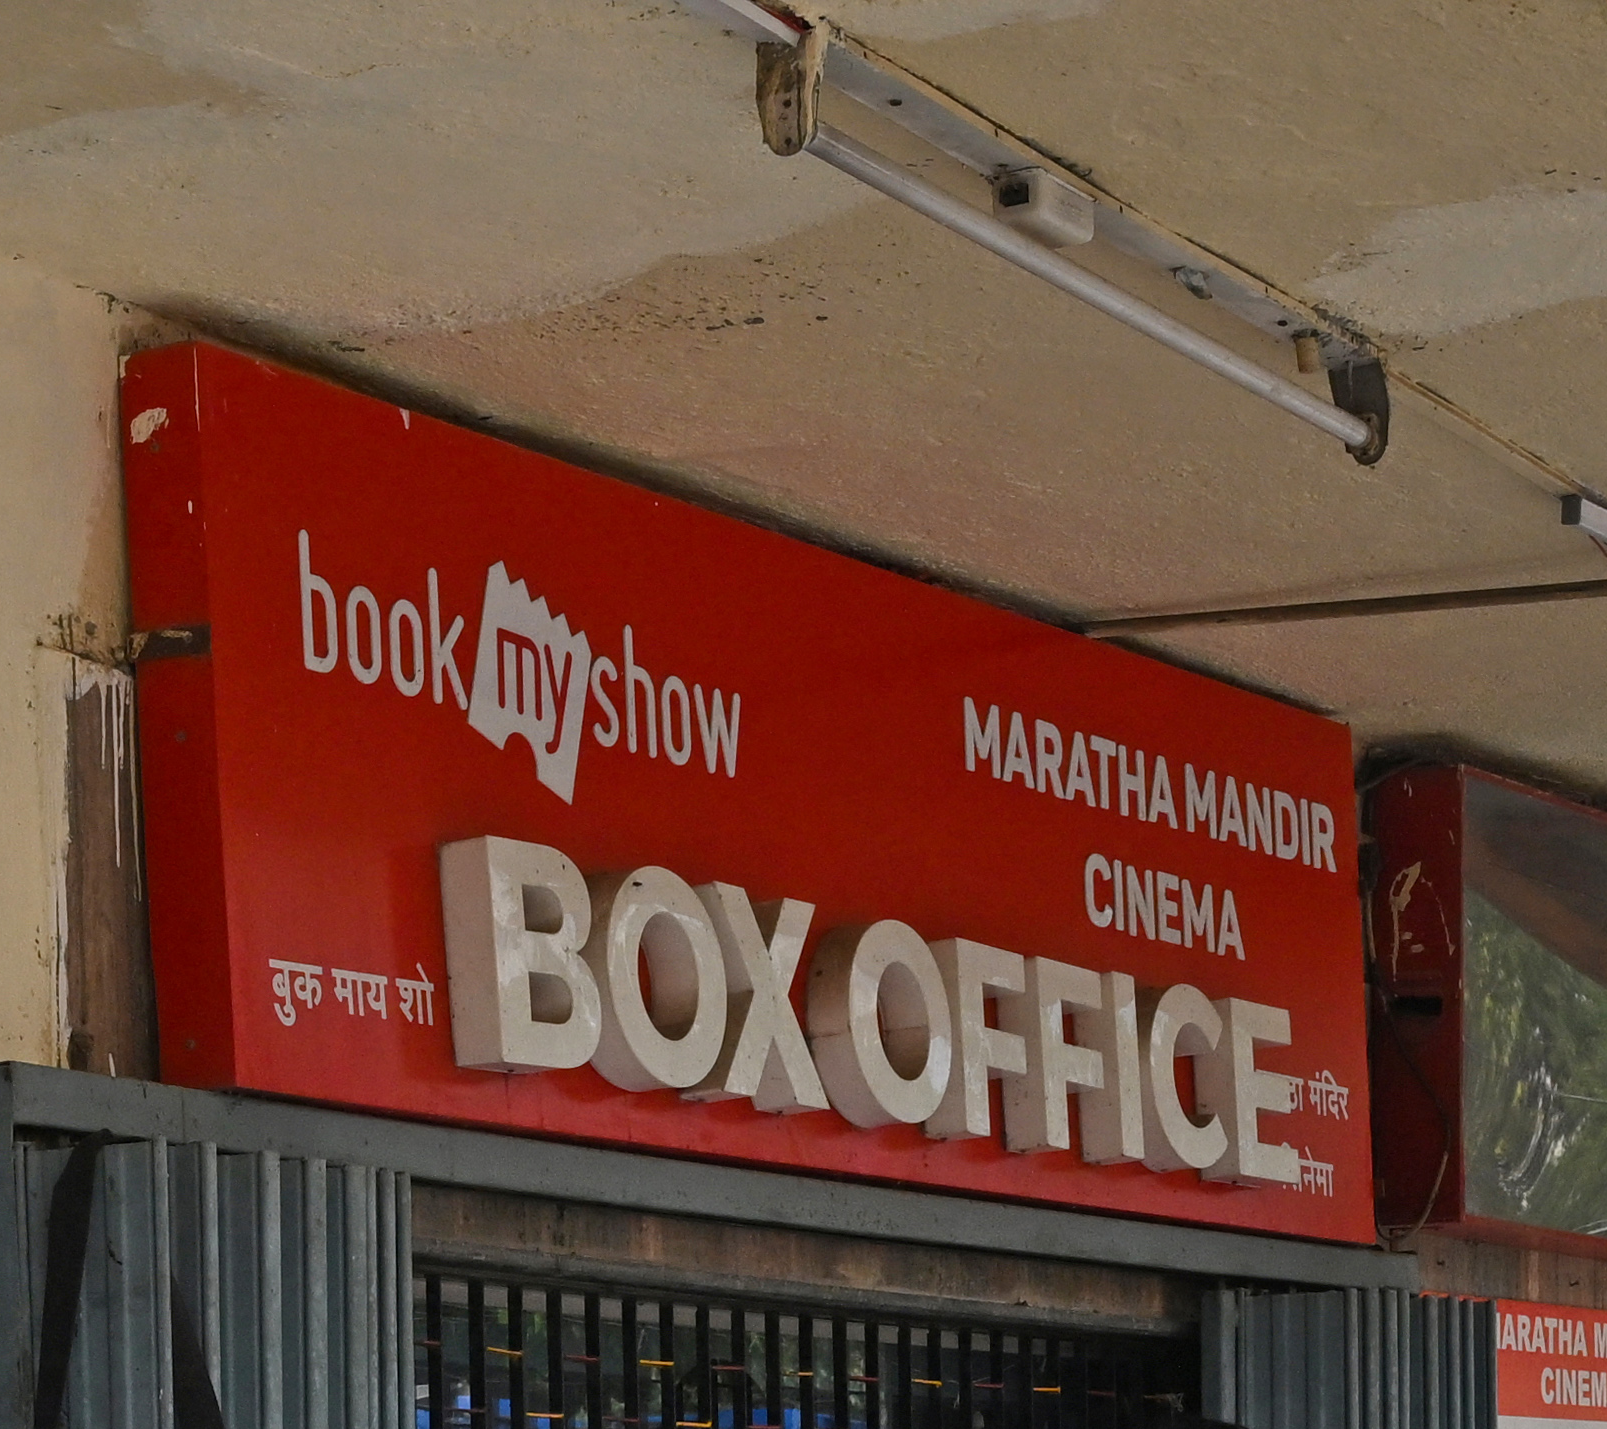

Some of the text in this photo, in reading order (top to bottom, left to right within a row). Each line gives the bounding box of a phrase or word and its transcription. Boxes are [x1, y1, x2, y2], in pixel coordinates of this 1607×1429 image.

[963, 694, 1338, 874] MARATHA MANDIR
[1084, 852, 1246, 963] CINEMA
[268, 958, 435, 1027] बुक माय शो
[440, 835, 1298, 1189] BOX OFFICE
